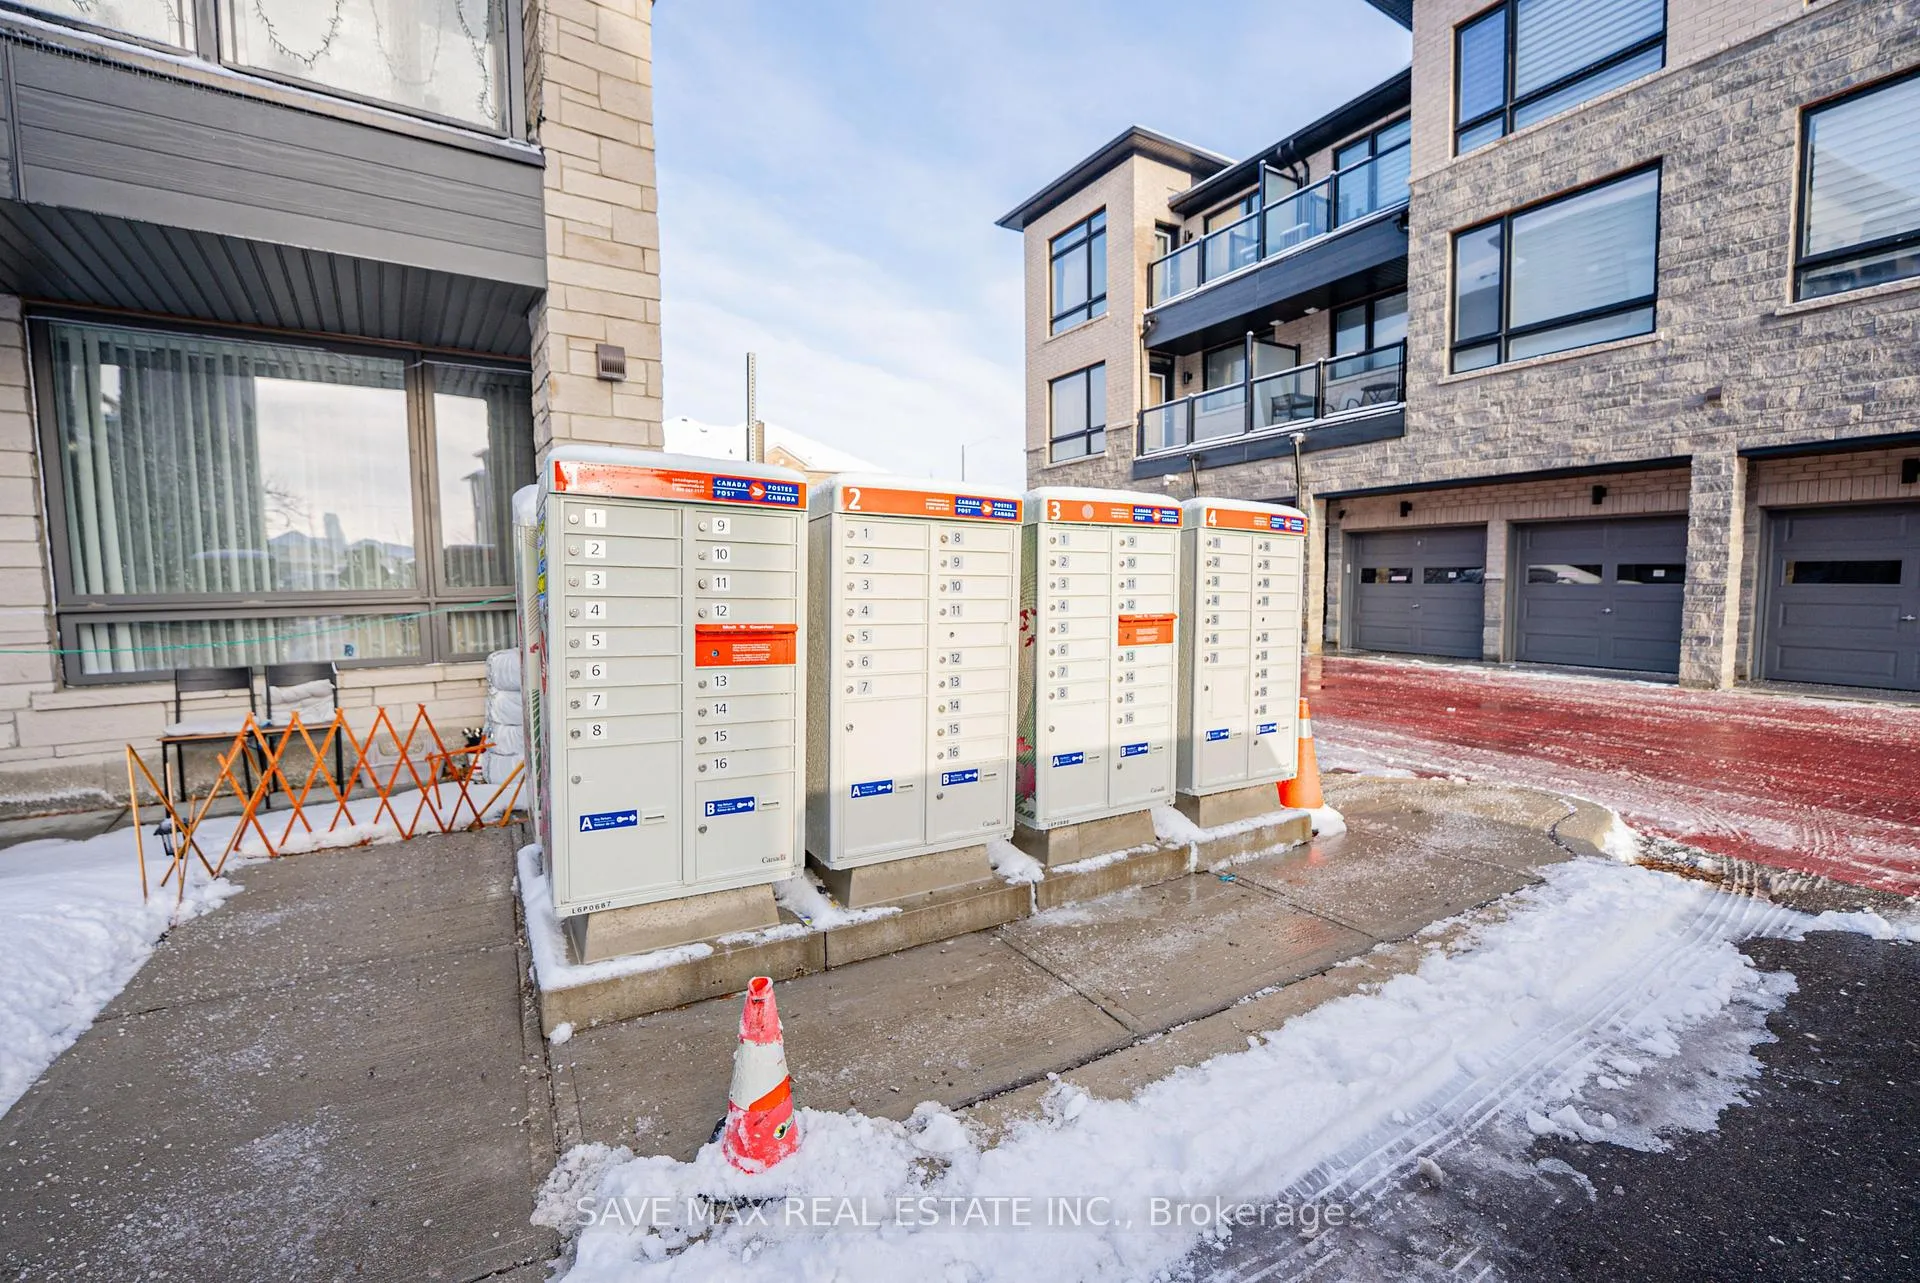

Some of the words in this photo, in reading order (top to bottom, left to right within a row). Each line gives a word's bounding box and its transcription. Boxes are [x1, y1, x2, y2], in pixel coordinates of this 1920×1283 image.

[716, 480, 747, 488] CANADA
[767, 485, 793, 493] POSTES
[848, 488, 861, 510] 2
[1050, 501, 1061, 520] 3
[1208, 510, 1217, 526] 4
[716, 548, 728, 560] 10
[716, 577, 727, 588] 11
[952, 581, 961, 591] 10
[715, 605, 727, 617] 12
[952, 605, 960, 615] 11
[951, 653, 960, 663] 12
[715, 675, 727, 687] 13
[950, 676, 960, 687] 13
[714, 703, 727, 714] 14
[950, 700, 959, 710] 14
[949, 723, 959, 734] 15
[715, 730, 727, 742] 15
[1206, 732, 1211, 740] A
[949, 747, 959, 757] 16
[1121, 747, 1127, 756] B
[714, 757, 728, 769] 16
[1053, 756, 1059, 766] A
[942, 774, 950, 785] B
[852, 786, 861, 797] A
[707, 803, 715, 815] B
[581, 816, 593, 830] A
